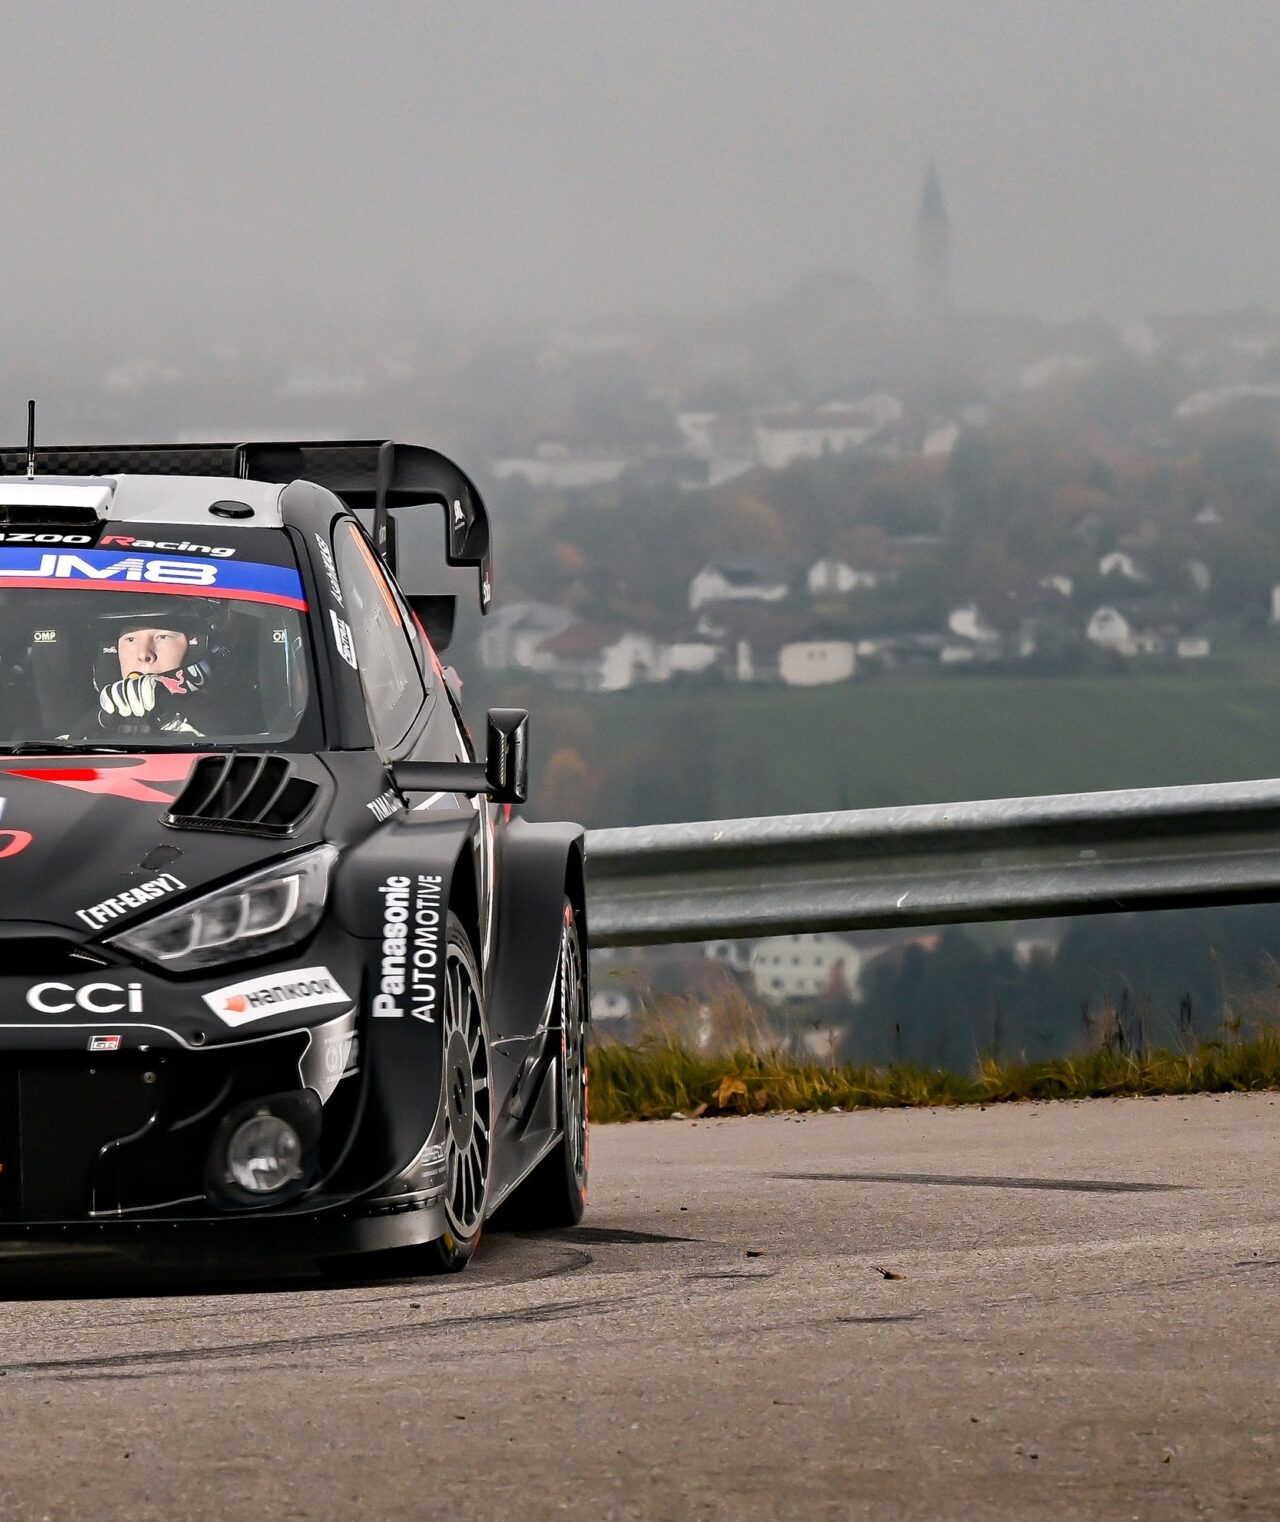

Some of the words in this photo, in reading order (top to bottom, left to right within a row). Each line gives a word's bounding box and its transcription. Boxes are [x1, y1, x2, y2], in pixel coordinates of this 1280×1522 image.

[100, 535, 236, 557] Racing
[33, 631, 57, 642] OMP
[372, 875, 412, 1018] Panasonic
[411, 874, 442, 1023] AUTOMOTIVE
